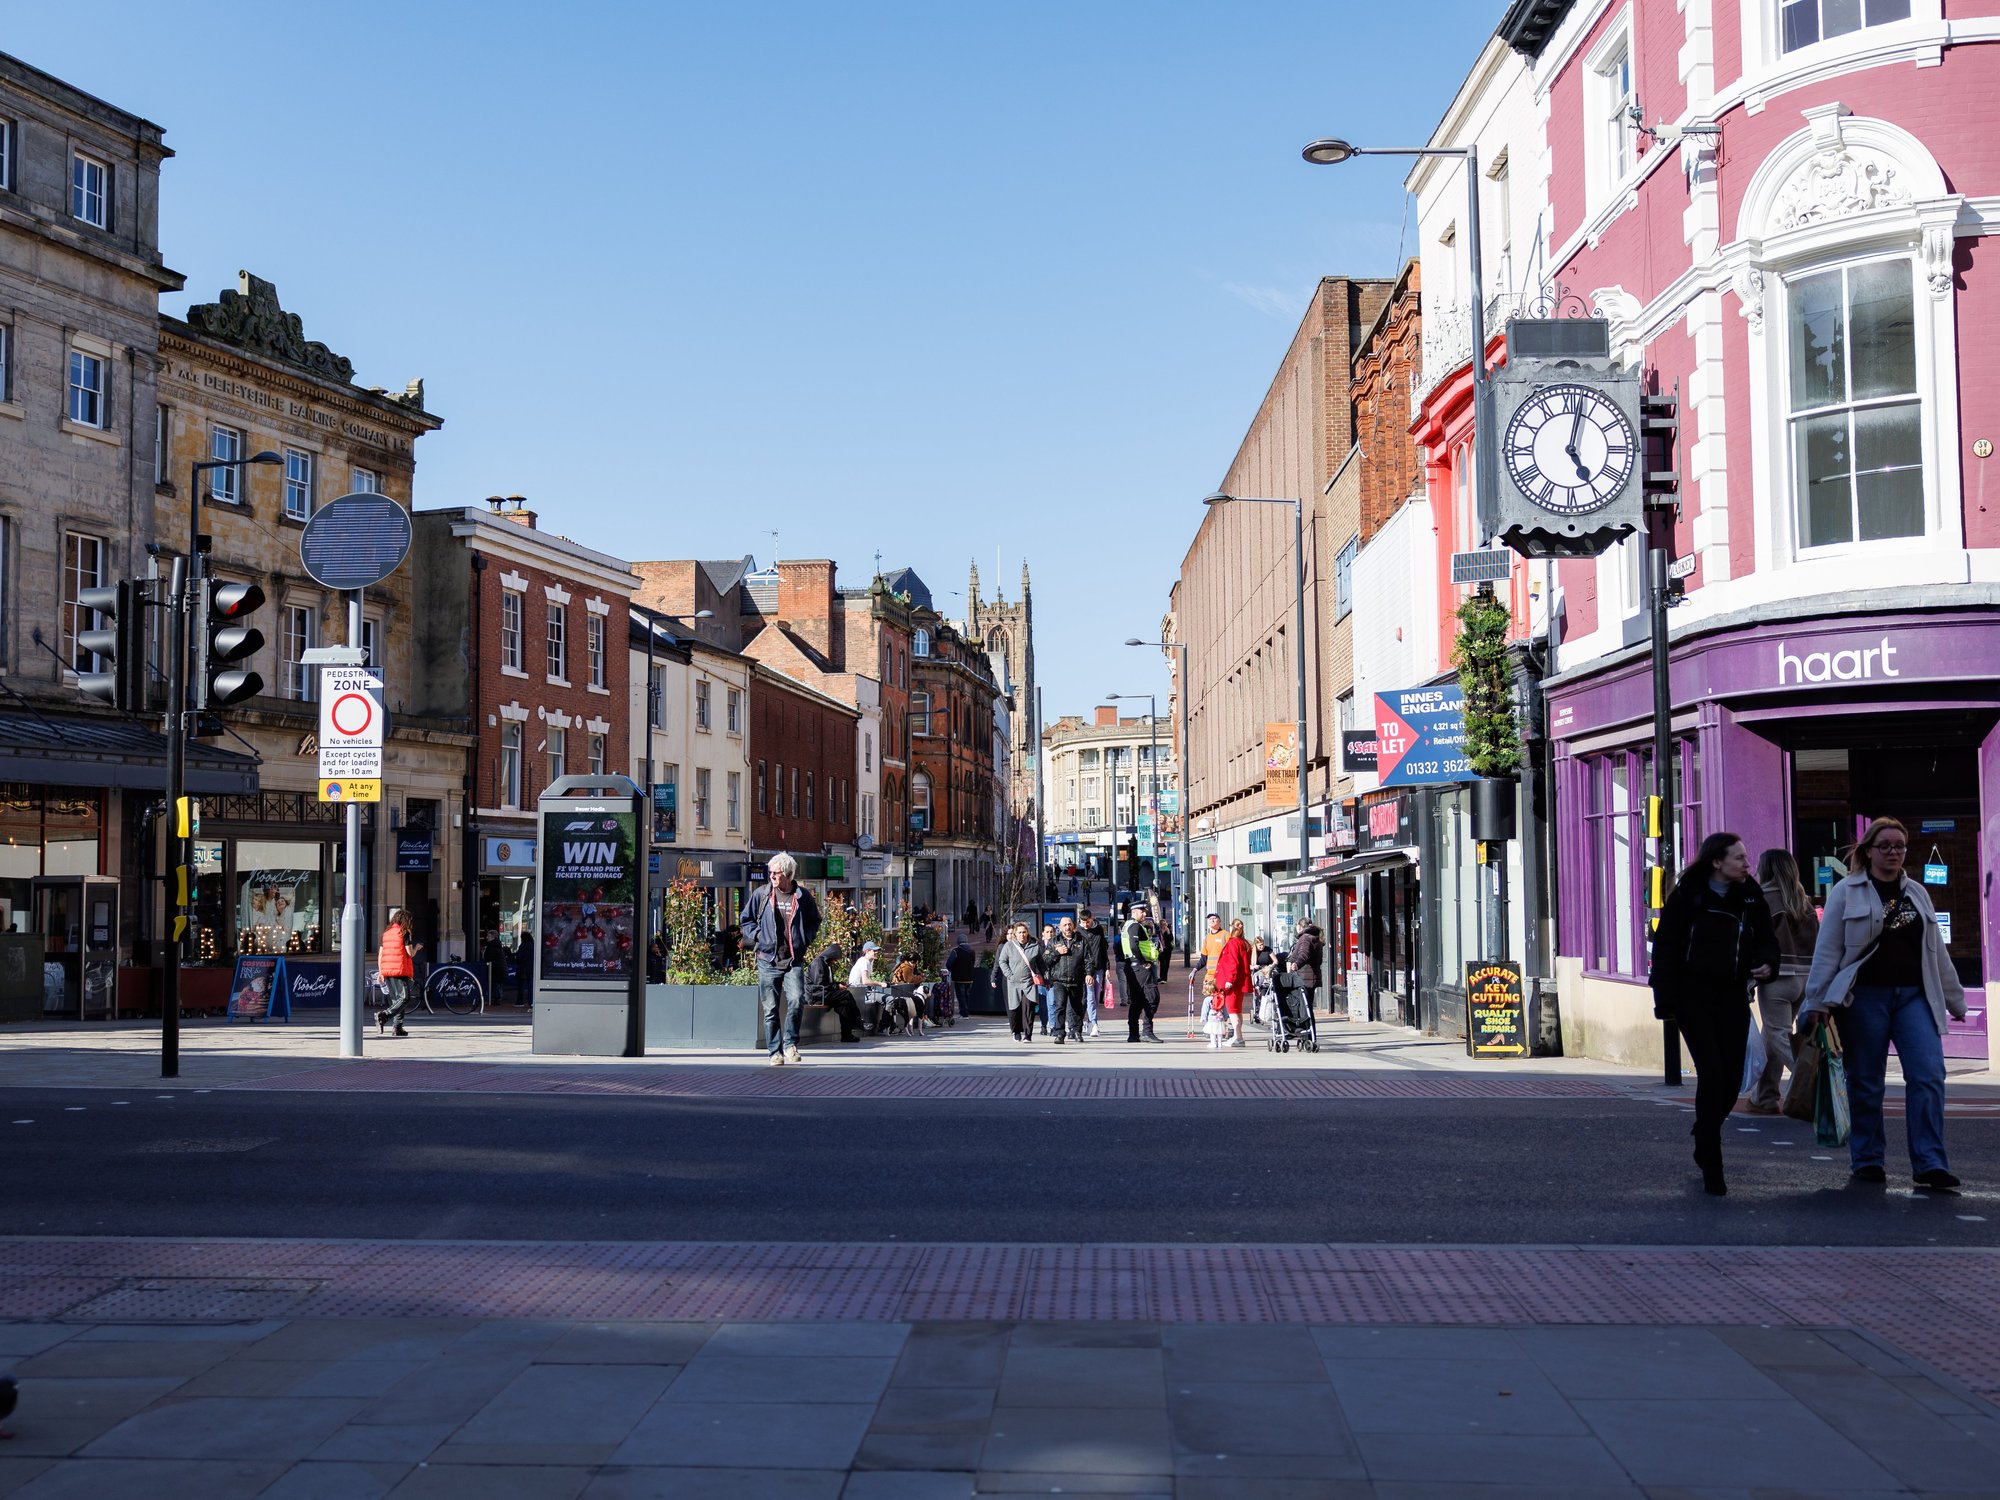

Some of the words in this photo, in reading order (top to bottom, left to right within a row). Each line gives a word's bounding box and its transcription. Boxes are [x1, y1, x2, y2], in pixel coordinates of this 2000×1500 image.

[204, 373, 285, 412] DERBYSHIRE
[290, 402, 338, 428] BANKING
[342, 420, 390, 446] COMPANY
[1778, 636, 1899, 685] haart
[333, 680, 371, 690] ZONE
[1400, 691, 1443, 704] INNES
[1381, 722, 1399, 737] TO
[1433, 722, 1449, 731] 4,321
[1450, 723, 1458, 731] sq
[1433, 735, 1466, 745] Retail/Off
[1382, 738, 1406, 754] LET
[325, 751, 351, 759] Except
[353, 751, 377, 759] cycles
[351, 759, 379, 768] loading
[1406, 761, 1438, 775] 01332
[1443, 758, 1471, 773] 3622
[1267, 769, 1281, 779] MORE
[1282, 769, 1296, 778] THAN
[563, 842, 617, 864] WIN
[700, 860, 714, 878] HILL
[1926, 870, 1946, 878] open
[751, 872, 764, 880] HILL
[1469, 966, 1519, 986] ACCURATE
[1484, 983, 1509, 993] KEY
[1471, 993, 1520, 1003] CUTTING
[1474, 1009, 1520, 1018] QUALITY
[1485, 1017, 1511, 1025] SHOE
[1481, 1025, 1517, 1033] REPAIRS
